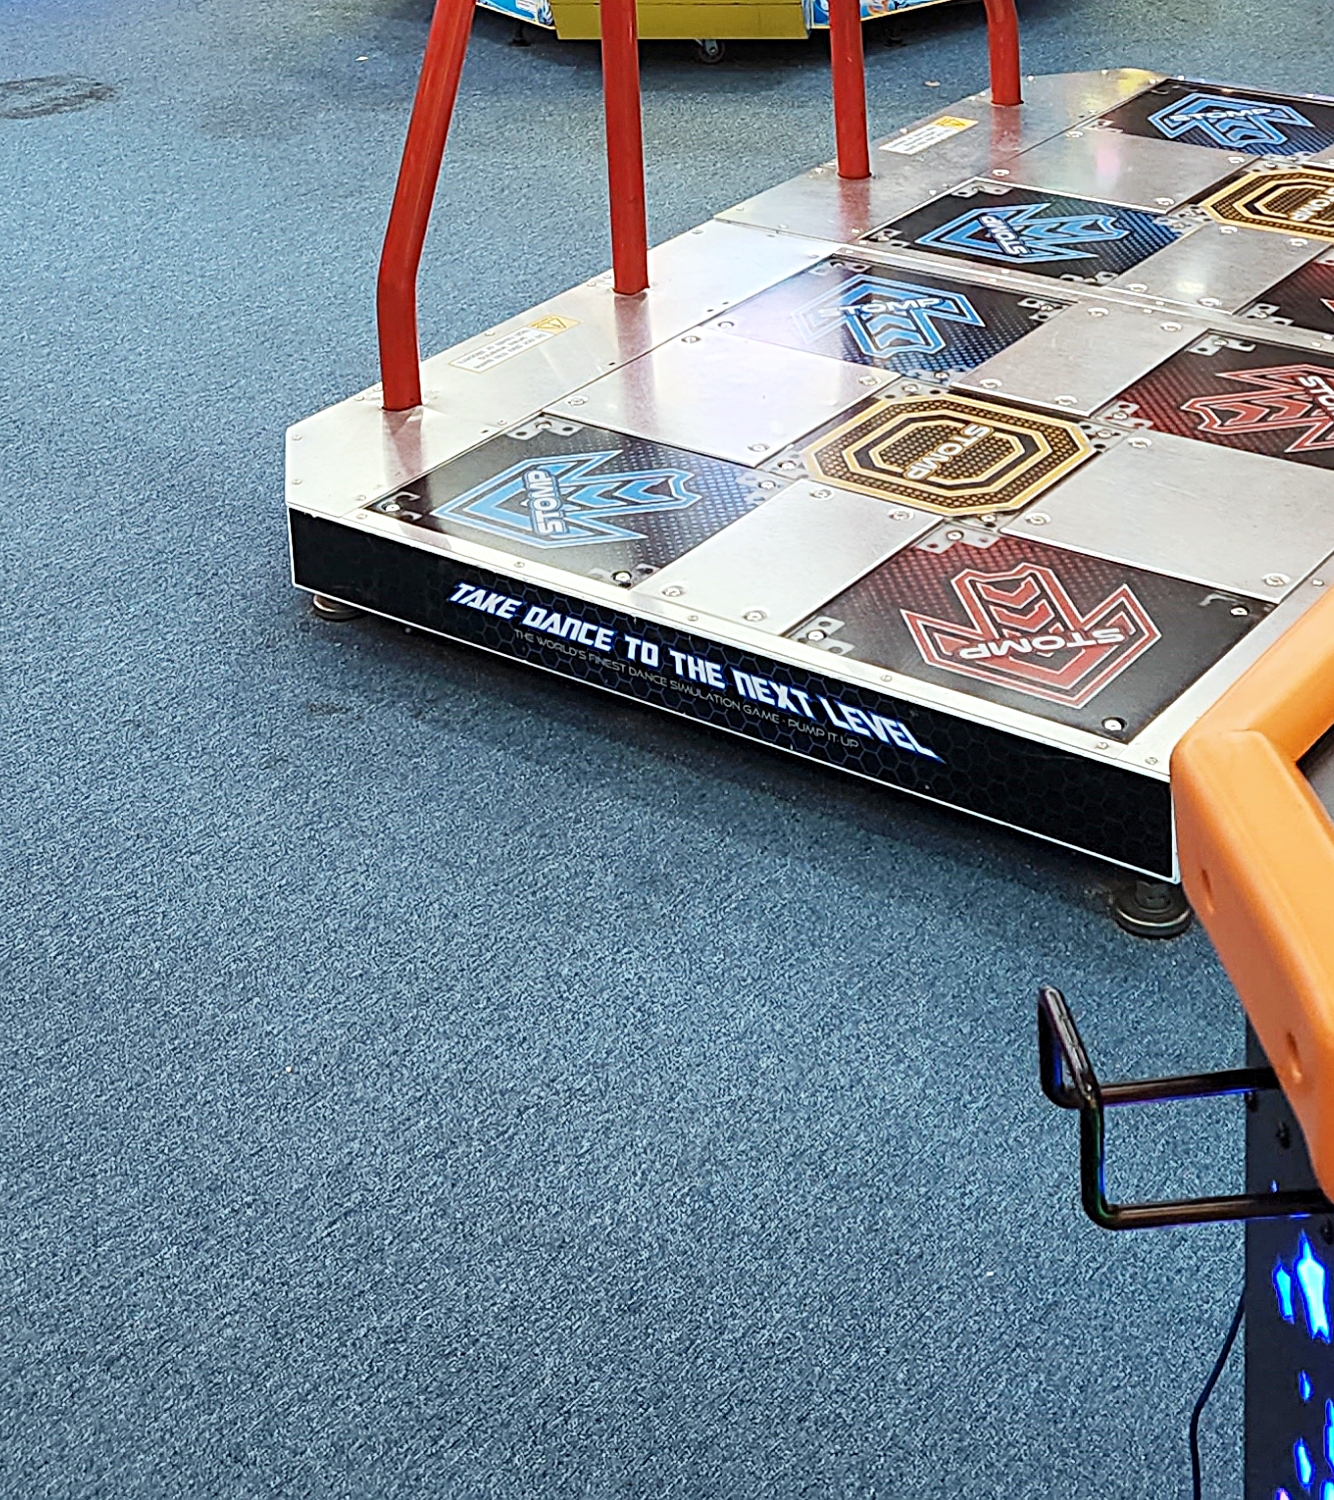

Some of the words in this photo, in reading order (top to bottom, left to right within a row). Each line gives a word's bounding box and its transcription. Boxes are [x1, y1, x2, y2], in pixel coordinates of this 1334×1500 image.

[1168, 106, 1273, 124] STOMP
[977, 212, 1028, 257] STOMP
[825, 294, 947, 317] STOMP
[902, 425, 992, 480] STOMP
[524, 469, 561, 536] STOMP
[960, 626, 1132, 661] STOMP
[448, 582, 523, 619] TAKE
[522, 605, 618, 651] DANCE
[623, 633, 660, 668] TO
[669, 647, 727, 690] THE
[732, 667, 816, 720] NEXT
[819, 695, 947, 765] LEVEL
[514, 628, 535, 645] THE
[537, 634, 587, 661] WORLD'S
[588, 652, 627, 674] FINEST
[628, 665, 667, 688] DANCE
[669, 679, 742, 712] SIMULATION
[742, 703, 780, 725] GAME
[787, 718, 824, 738] PUMP
[827, 730, 839, 743] IT
[839, 734, 859, 749] UP
